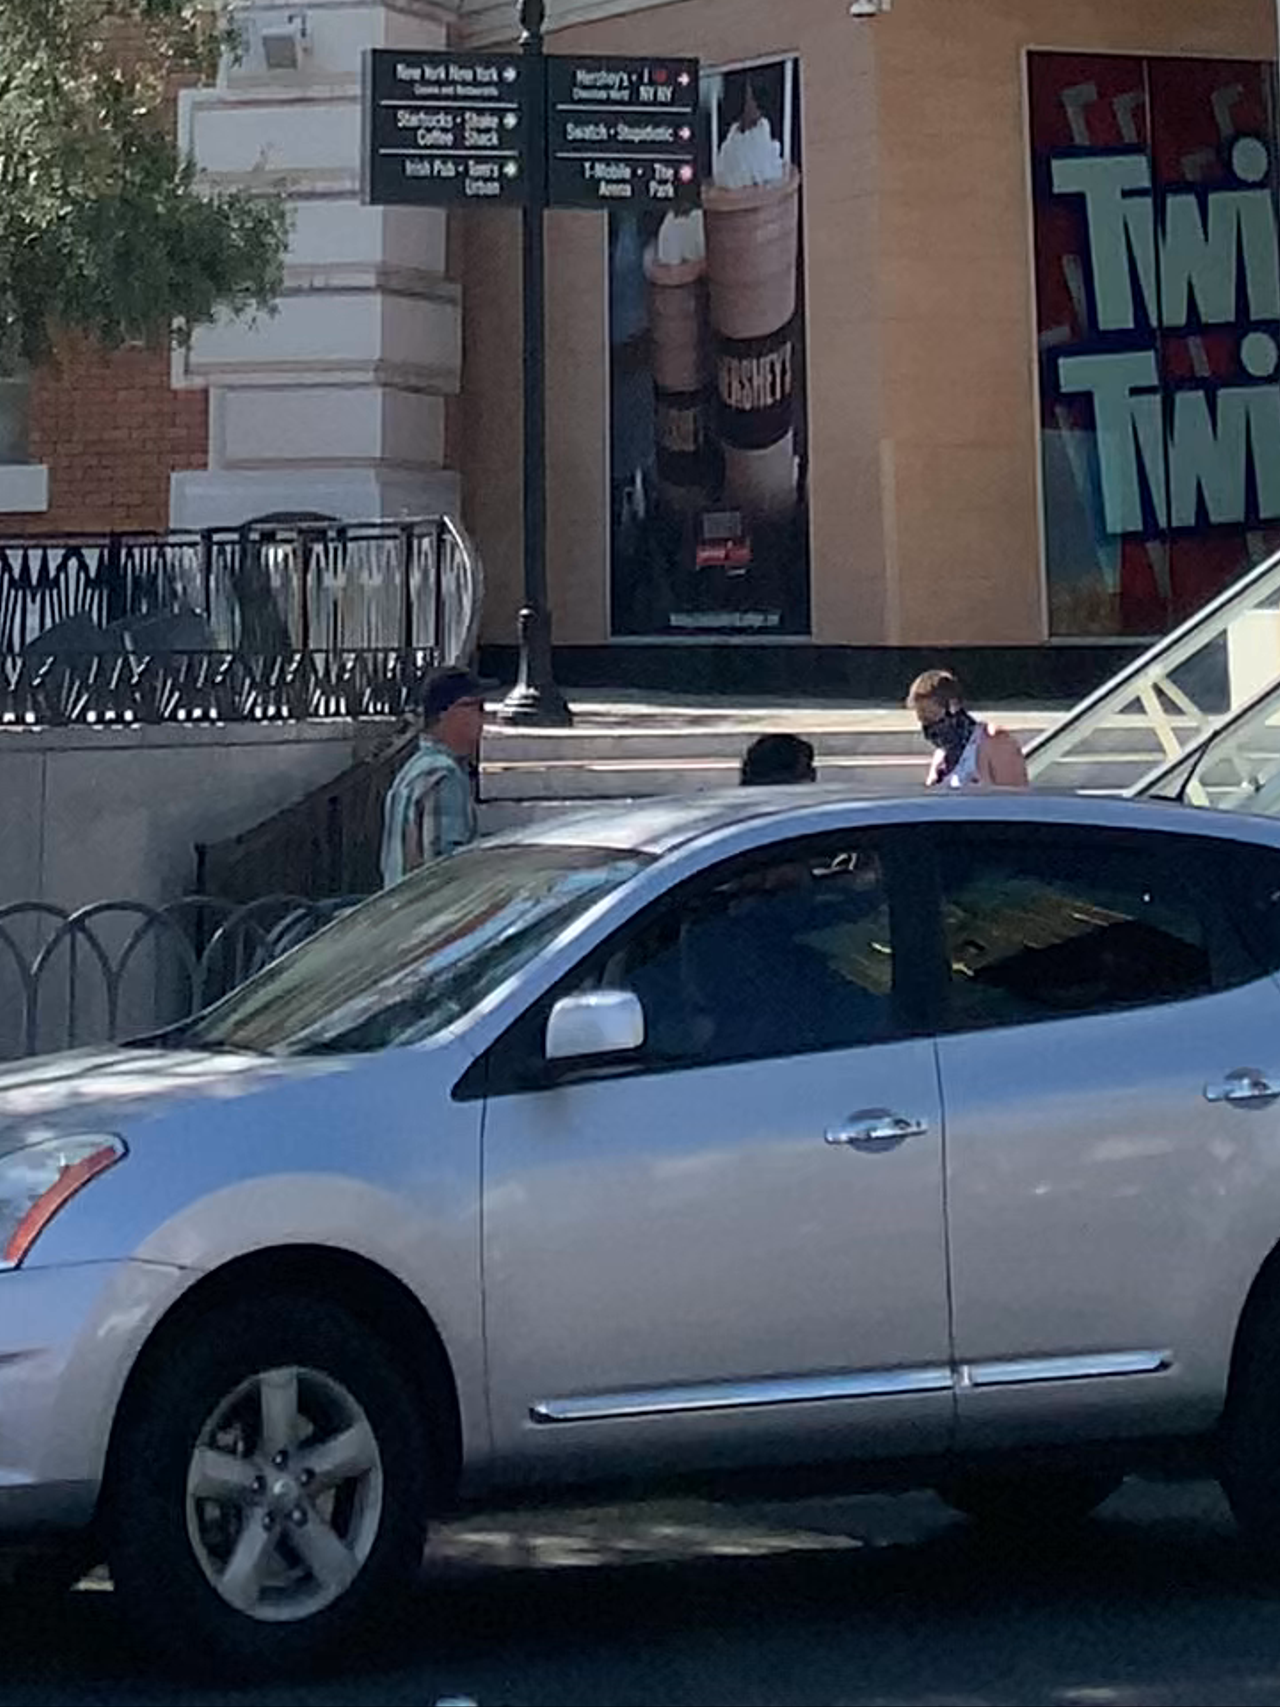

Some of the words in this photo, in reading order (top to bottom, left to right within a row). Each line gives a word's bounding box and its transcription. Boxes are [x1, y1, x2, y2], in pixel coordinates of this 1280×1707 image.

[397, 110, 453, 128] Starbucks
[433, 159, 456, 177] Pub
[583, 161, 631, 179] T-Mobile
[653, 162, 674, 180] The
